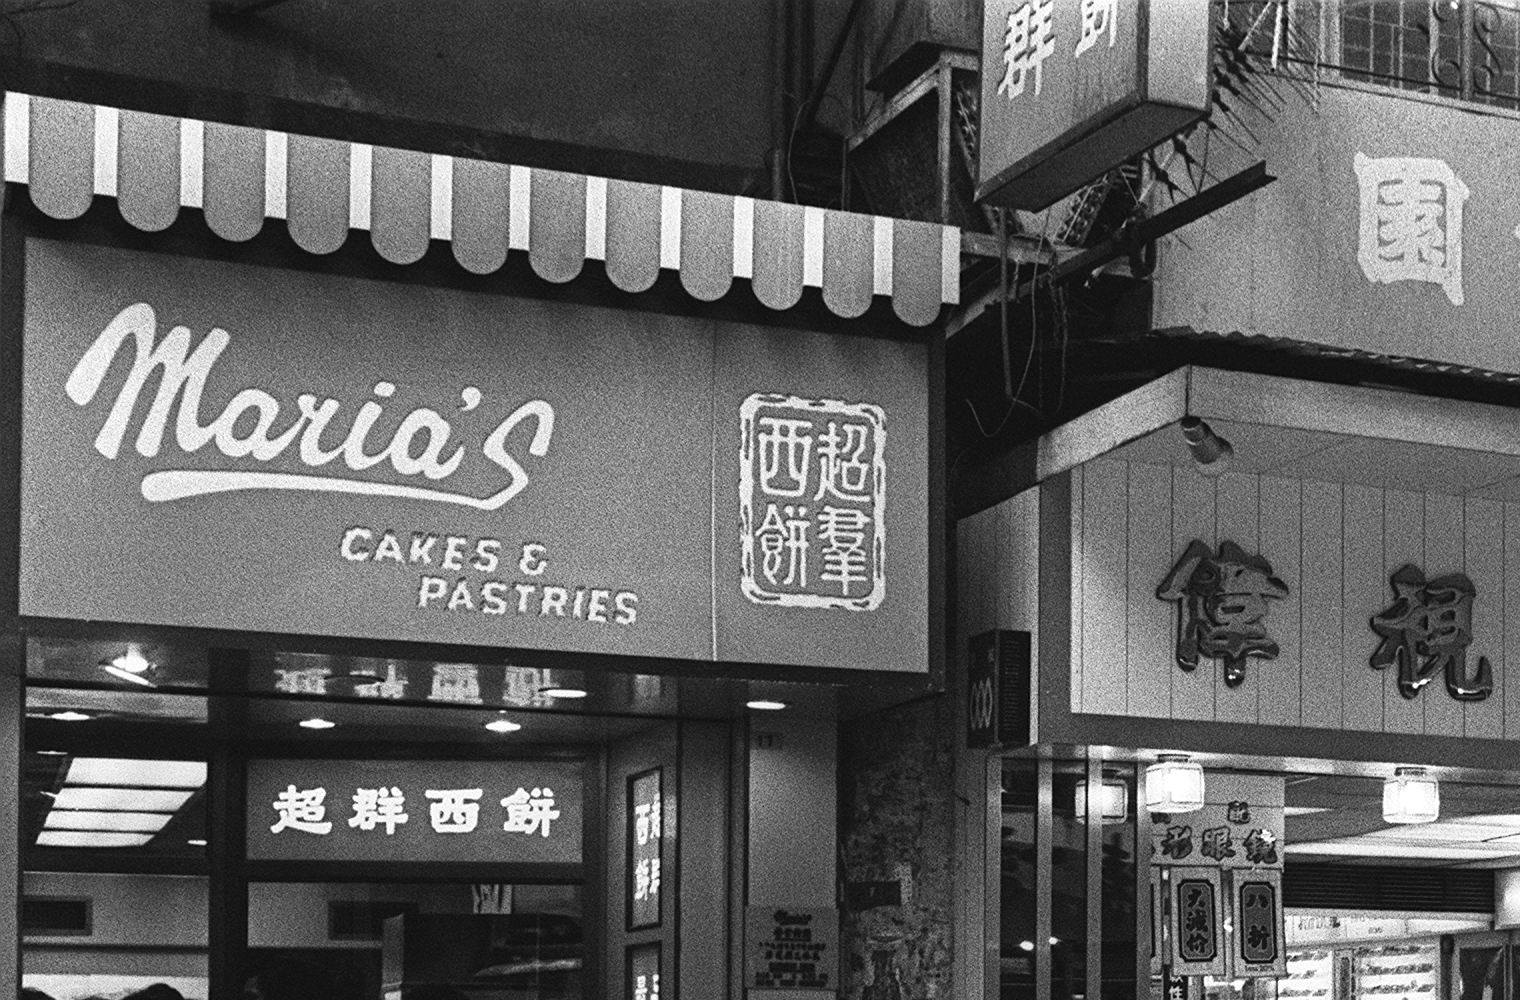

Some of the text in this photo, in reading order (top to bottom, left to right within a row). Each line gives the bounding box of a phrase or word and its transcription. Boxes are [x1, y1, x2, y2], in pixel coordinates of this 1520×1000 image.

[65, 302, 556, 511] Maria's
[340, 528, 548, 576] CAKES &
[417, 575, 639, 624] PASTRIES
[270, 783, 561, 837] 超群西餅
[1151, 825, 1279, 865] 形眼鏡
